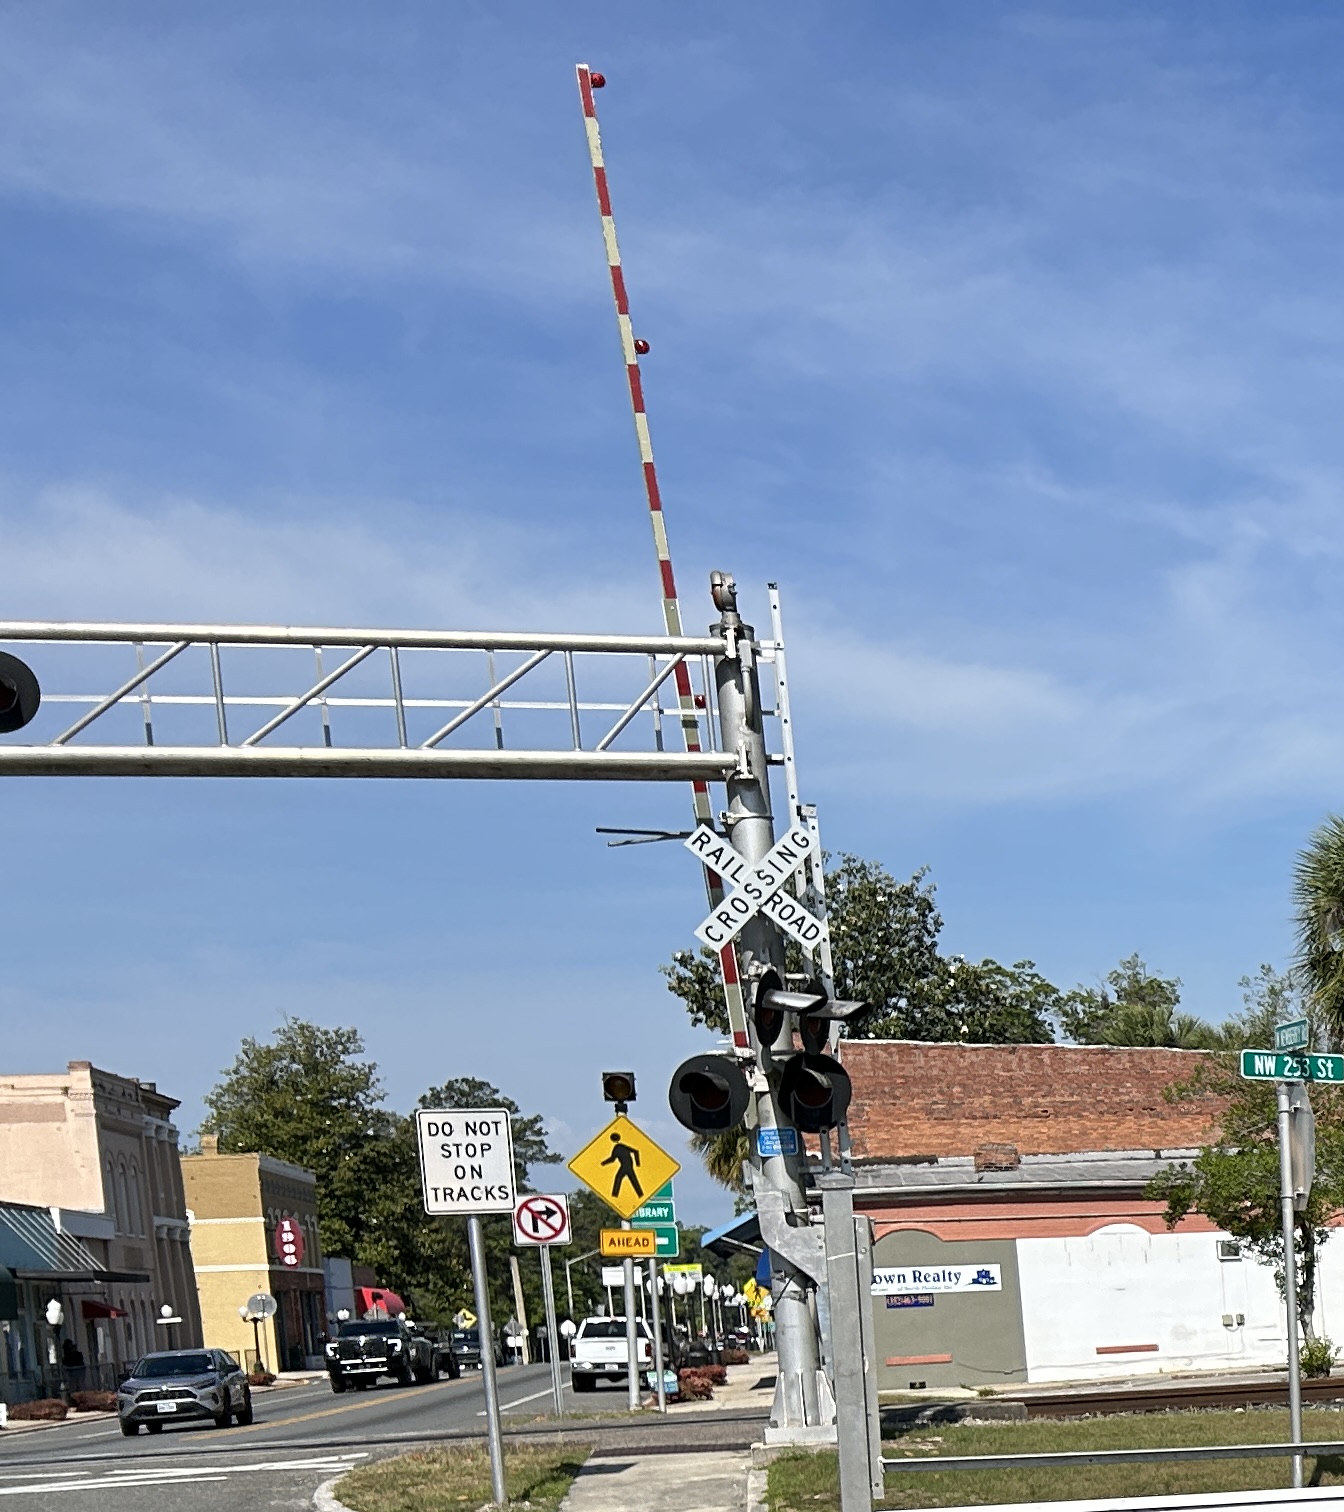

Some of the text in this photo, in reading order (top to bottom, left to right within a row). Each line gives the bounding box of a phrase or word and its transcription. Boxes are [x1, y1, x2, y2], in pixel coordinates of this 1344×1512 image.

[691, 831, 744, 884] RAIL
[704, 831, 810, 943] CROSSING
[767, 891, 821, 942] ROAD
[1253, 1054, 1277, 1076] NW
[1316, 1057, 1335, 1079] St
[427, 1120, 502, 1137] DO NOT
[440, 1142, 492, 1159] STOP
[453, 1163, 483, 1180] ON
[430, 1185, 510, 1203] TRACKS
[633, 1206, 669, 1218] IBRARY
[608, 1236, 650, 1248] AHEAD
[872, 1269, 962, 1286] own Realty
